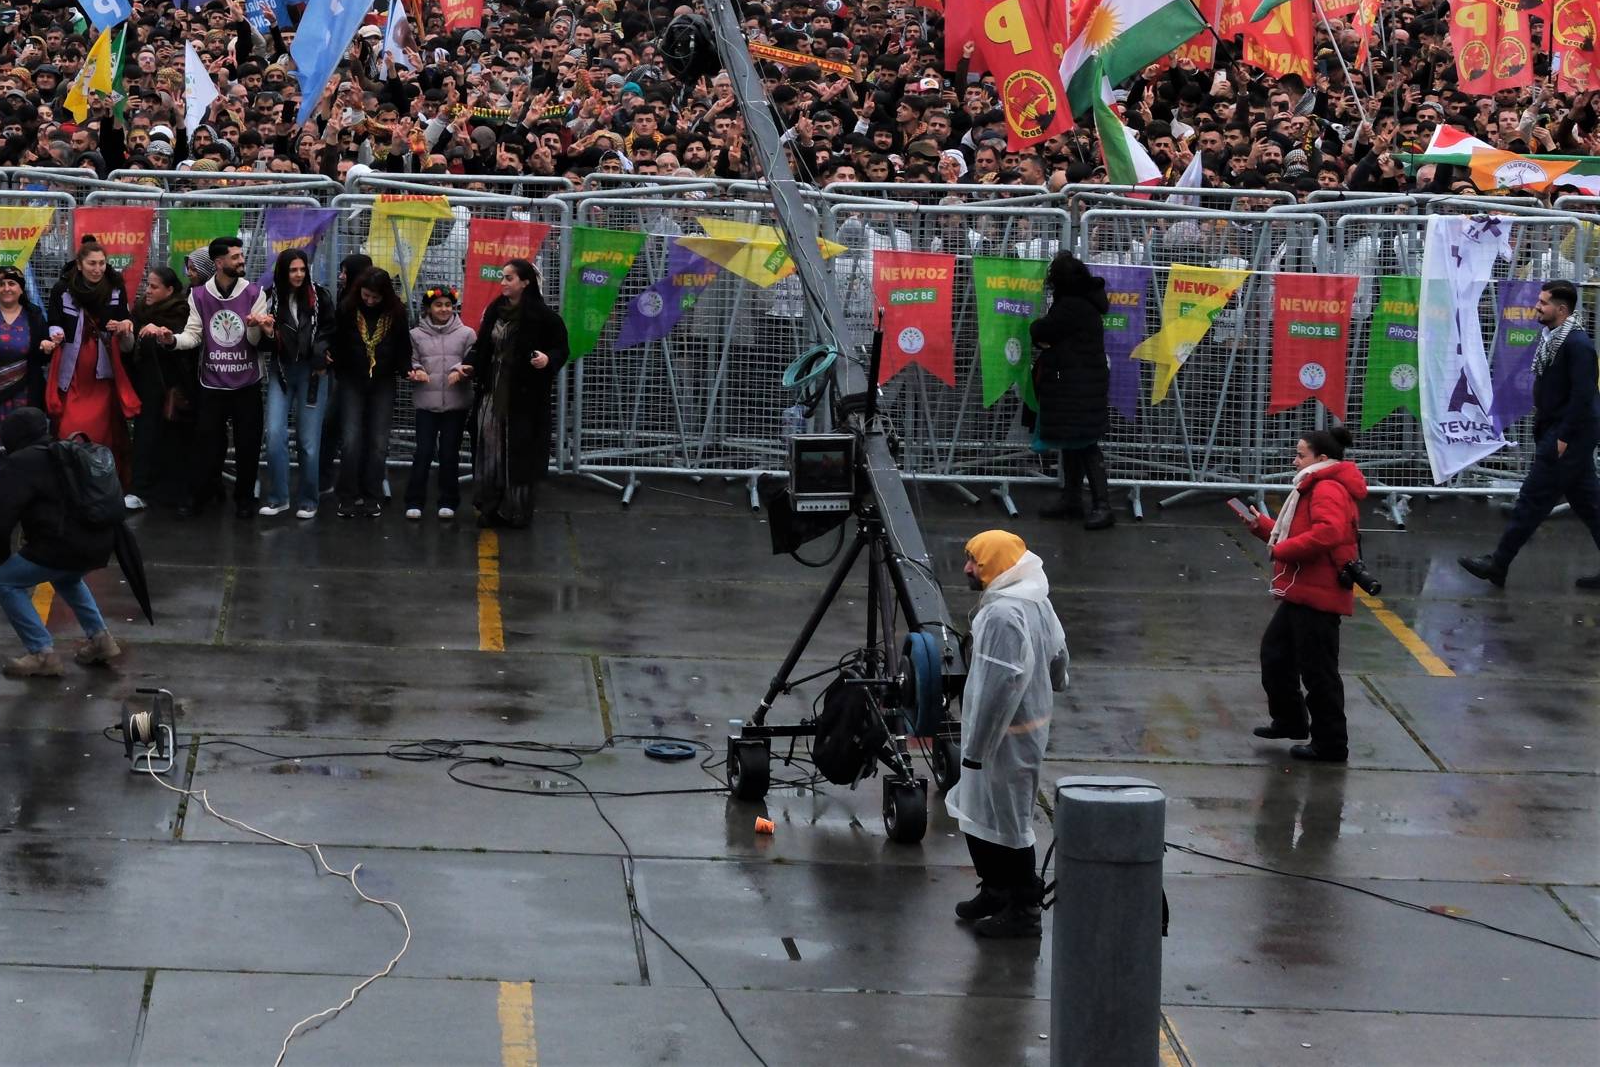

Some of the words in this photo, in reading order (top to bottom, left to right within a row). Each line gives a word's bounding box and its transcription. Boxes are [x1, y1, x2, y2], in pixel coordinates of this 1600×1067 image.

[94, 231, 145, 247] EWROZ
[879, 266, 948, 281] NEWROZ
[921, 290, 934, 301] BE
[1279, 297, 1347, 315] NEWROZ
[1112, 317, 1125, 327] BE
[1323, 325, 1337, 337] BE
[209, 349, 248, 361] GÖREVLİ
